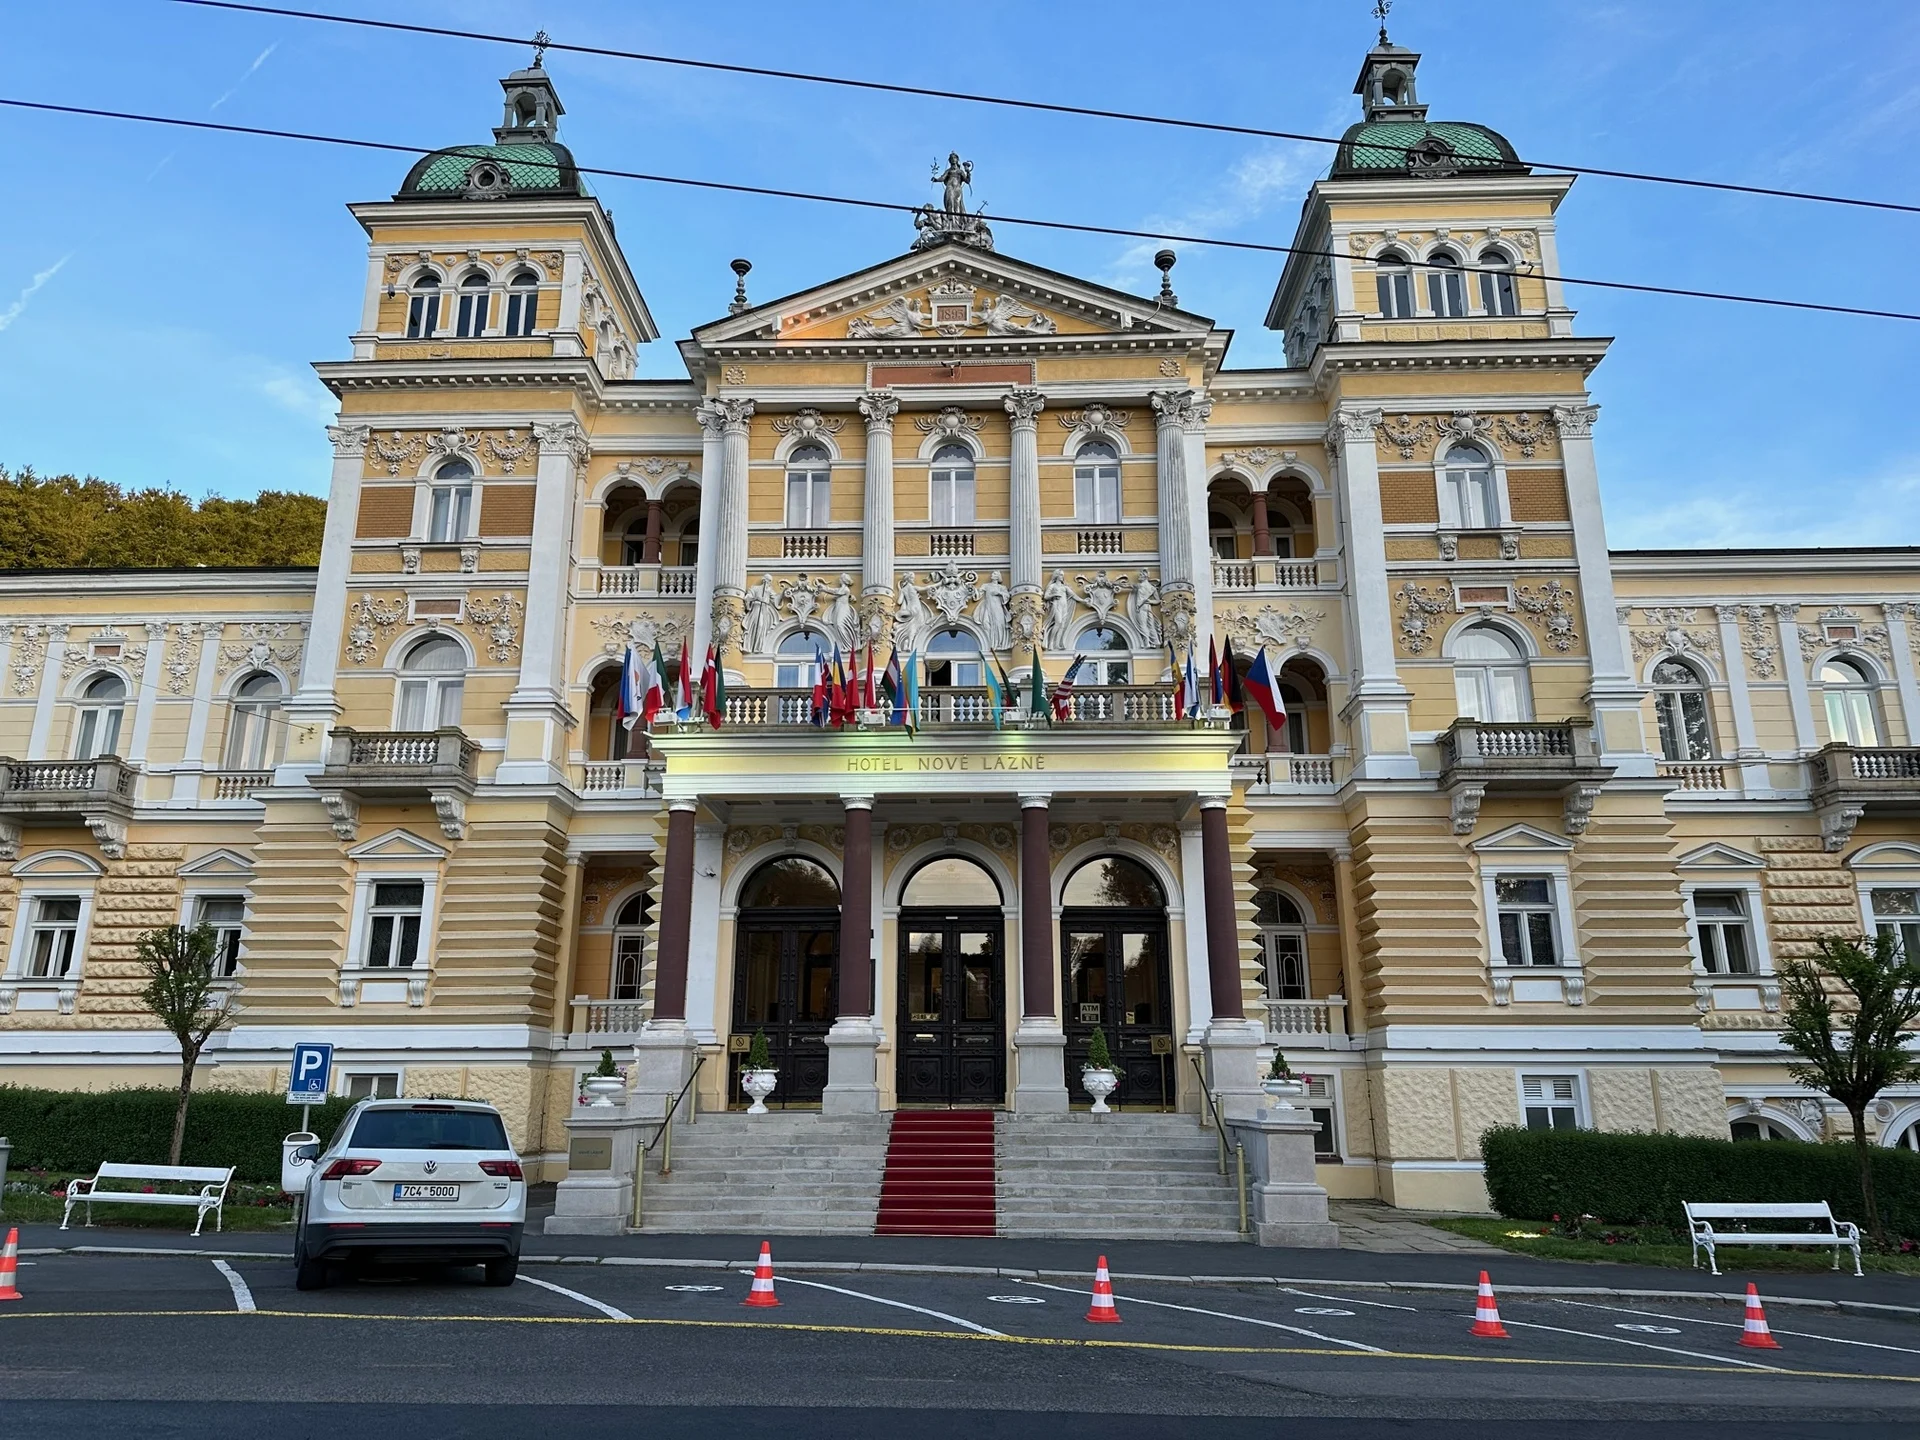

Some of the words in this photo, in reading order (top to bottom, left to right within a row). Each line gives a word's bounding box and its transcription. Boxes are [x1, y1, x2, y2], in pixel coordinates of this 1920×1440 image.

[847, 757, 903, 771] HOTEL
[918, 754, 969, 770] NOVÉ
[299, 1050, 323, 1081] P
[403, 1186, 422, 1197] 7C4
[429, 1186, 455, 1197] 5000
